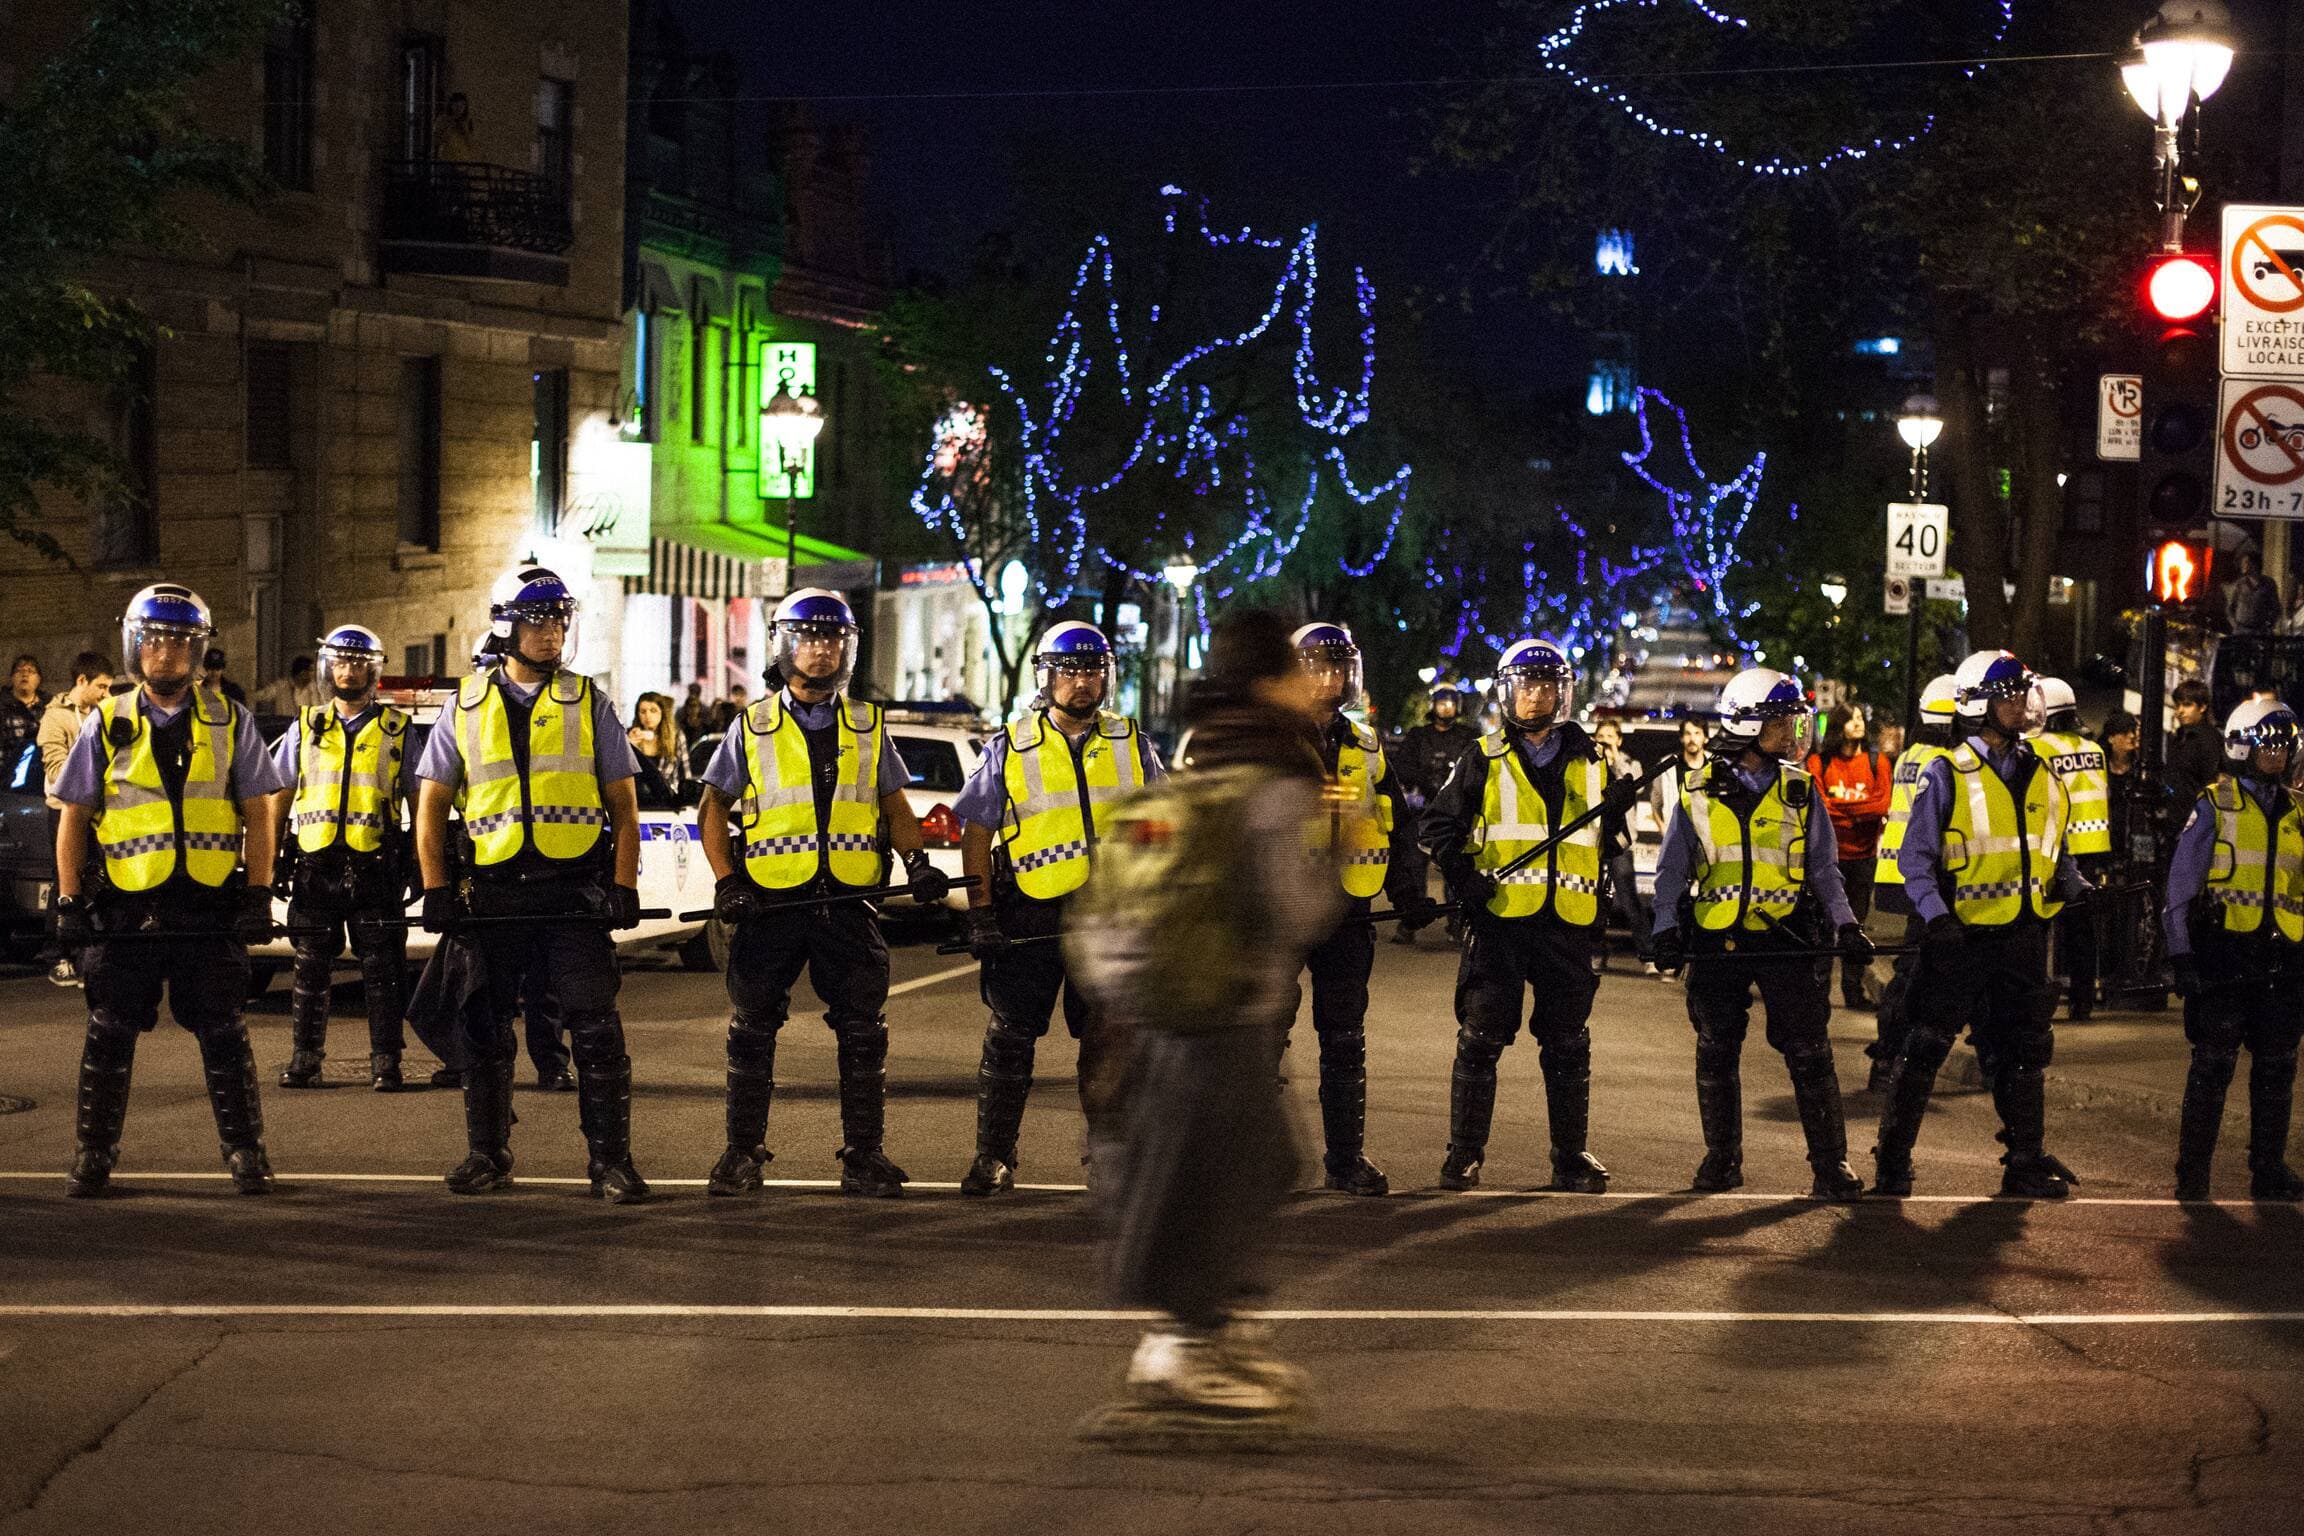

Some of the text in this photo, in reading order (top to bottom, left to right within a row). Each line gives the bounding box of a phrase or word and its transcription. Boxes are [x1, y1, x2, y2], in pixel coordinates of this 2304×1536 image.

[2248, 352, 2304, 365] LOCALE
[2224, 489, 2270, 509] 23h
[1895, 523, 1938, 557] 40
[2053, 753, 2101, 774] POLICE
